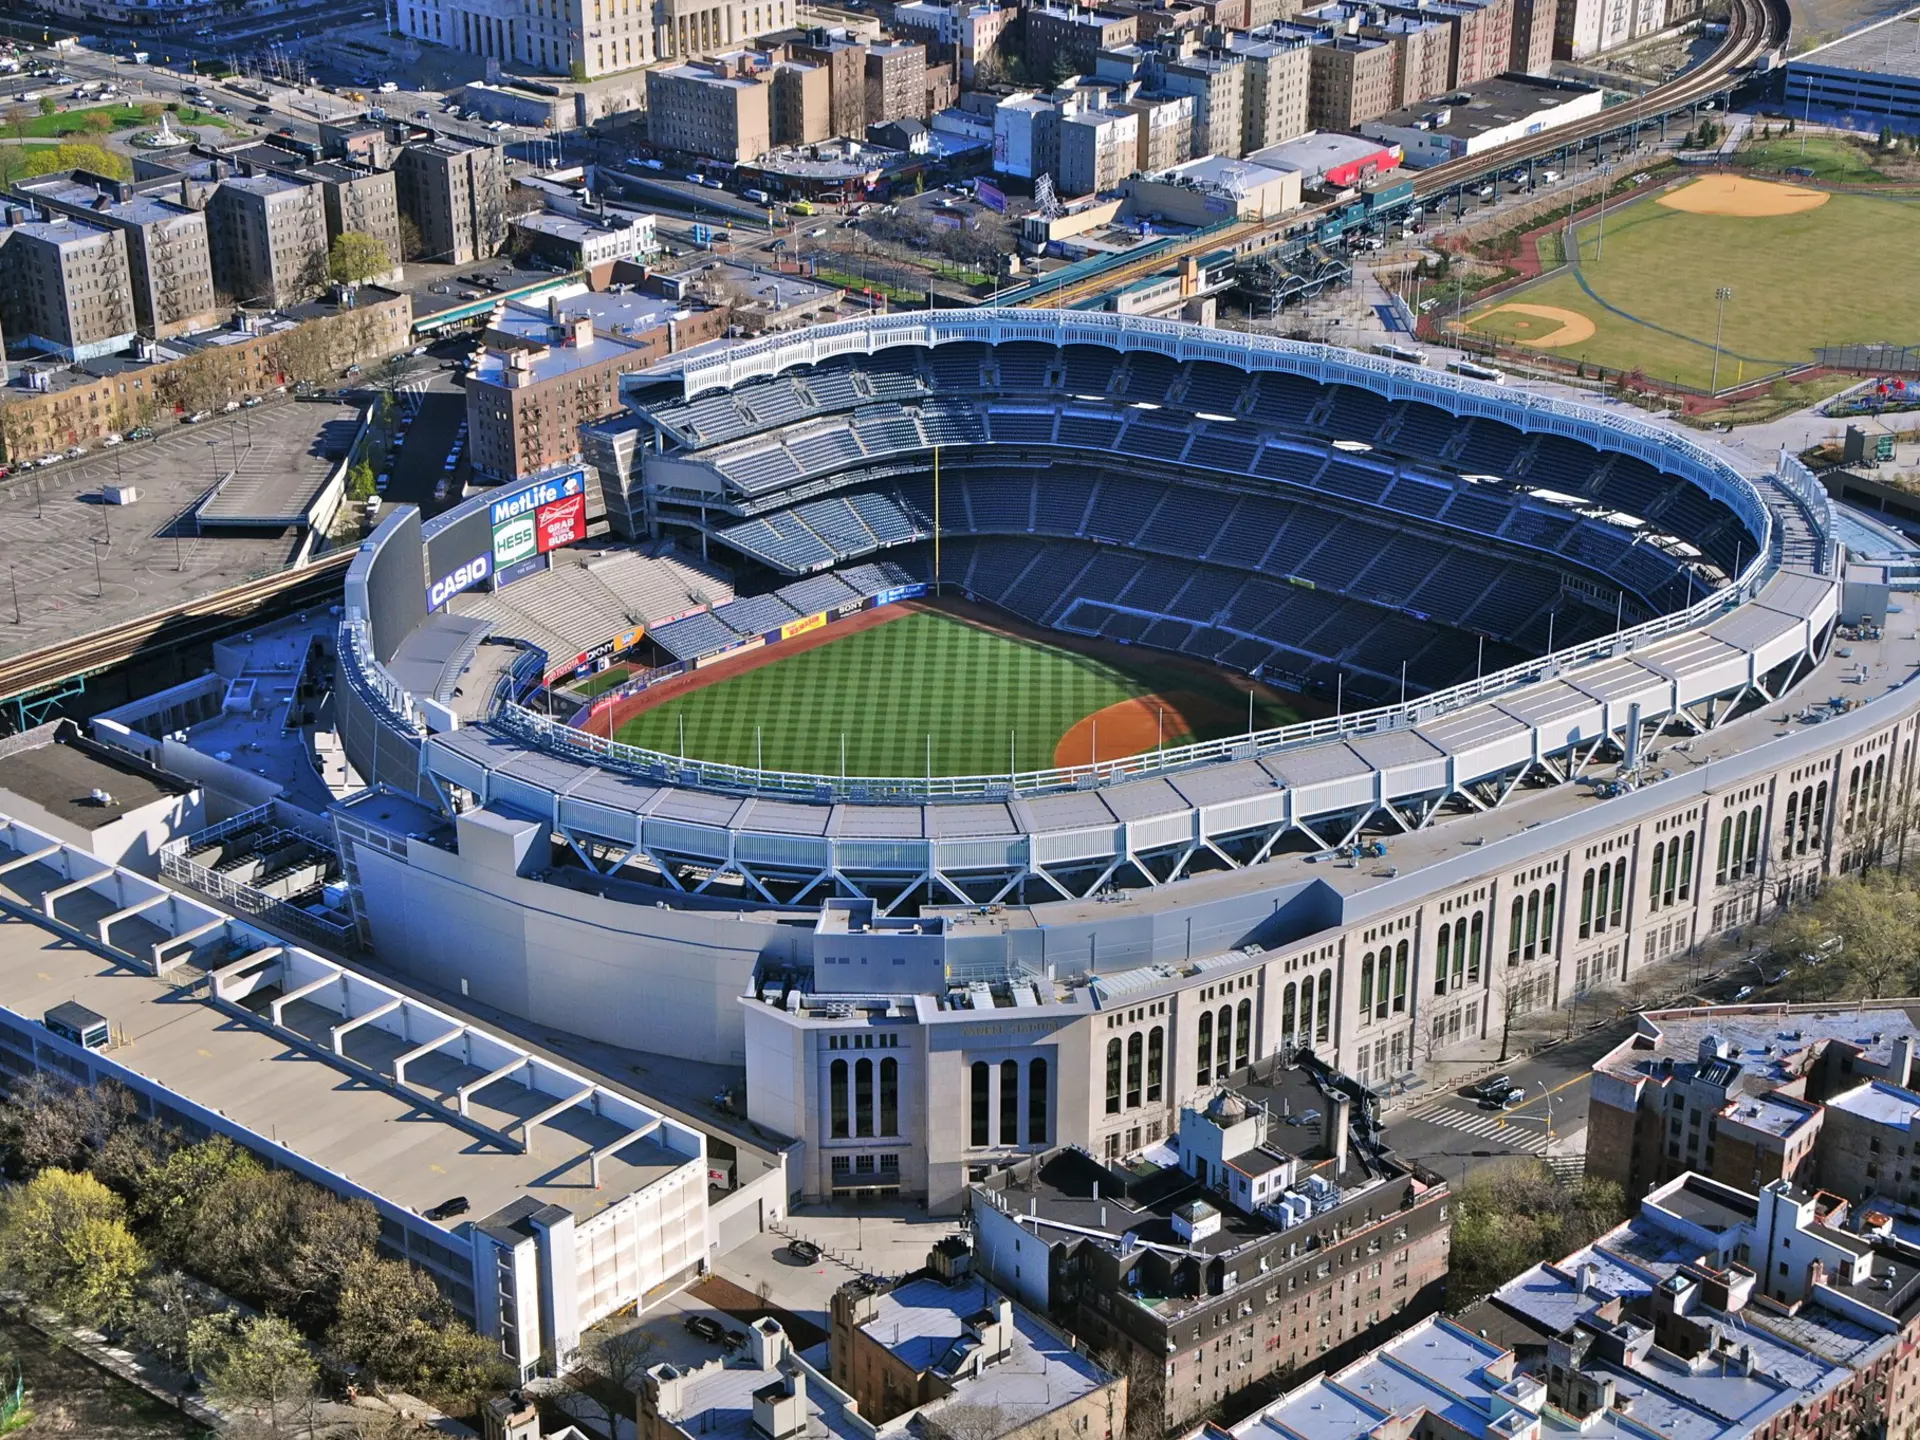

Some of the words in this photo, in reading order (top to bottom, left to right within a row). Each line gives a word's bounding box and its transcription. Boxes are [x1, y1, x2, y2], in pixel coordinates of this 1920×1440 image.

[495, 485, 557, 523] MetLife
[548, 518, 574, 533] GRAB
[496, 527, 532, 554] HESS
[549, 531, 575, 546] BUDS
[431, 556, 487, 606] CASIO
[838, 600, 864, 614] SONY
[587, 641, 614, 660] DKNY
[555, 660, 579, 677] TOYOTA
